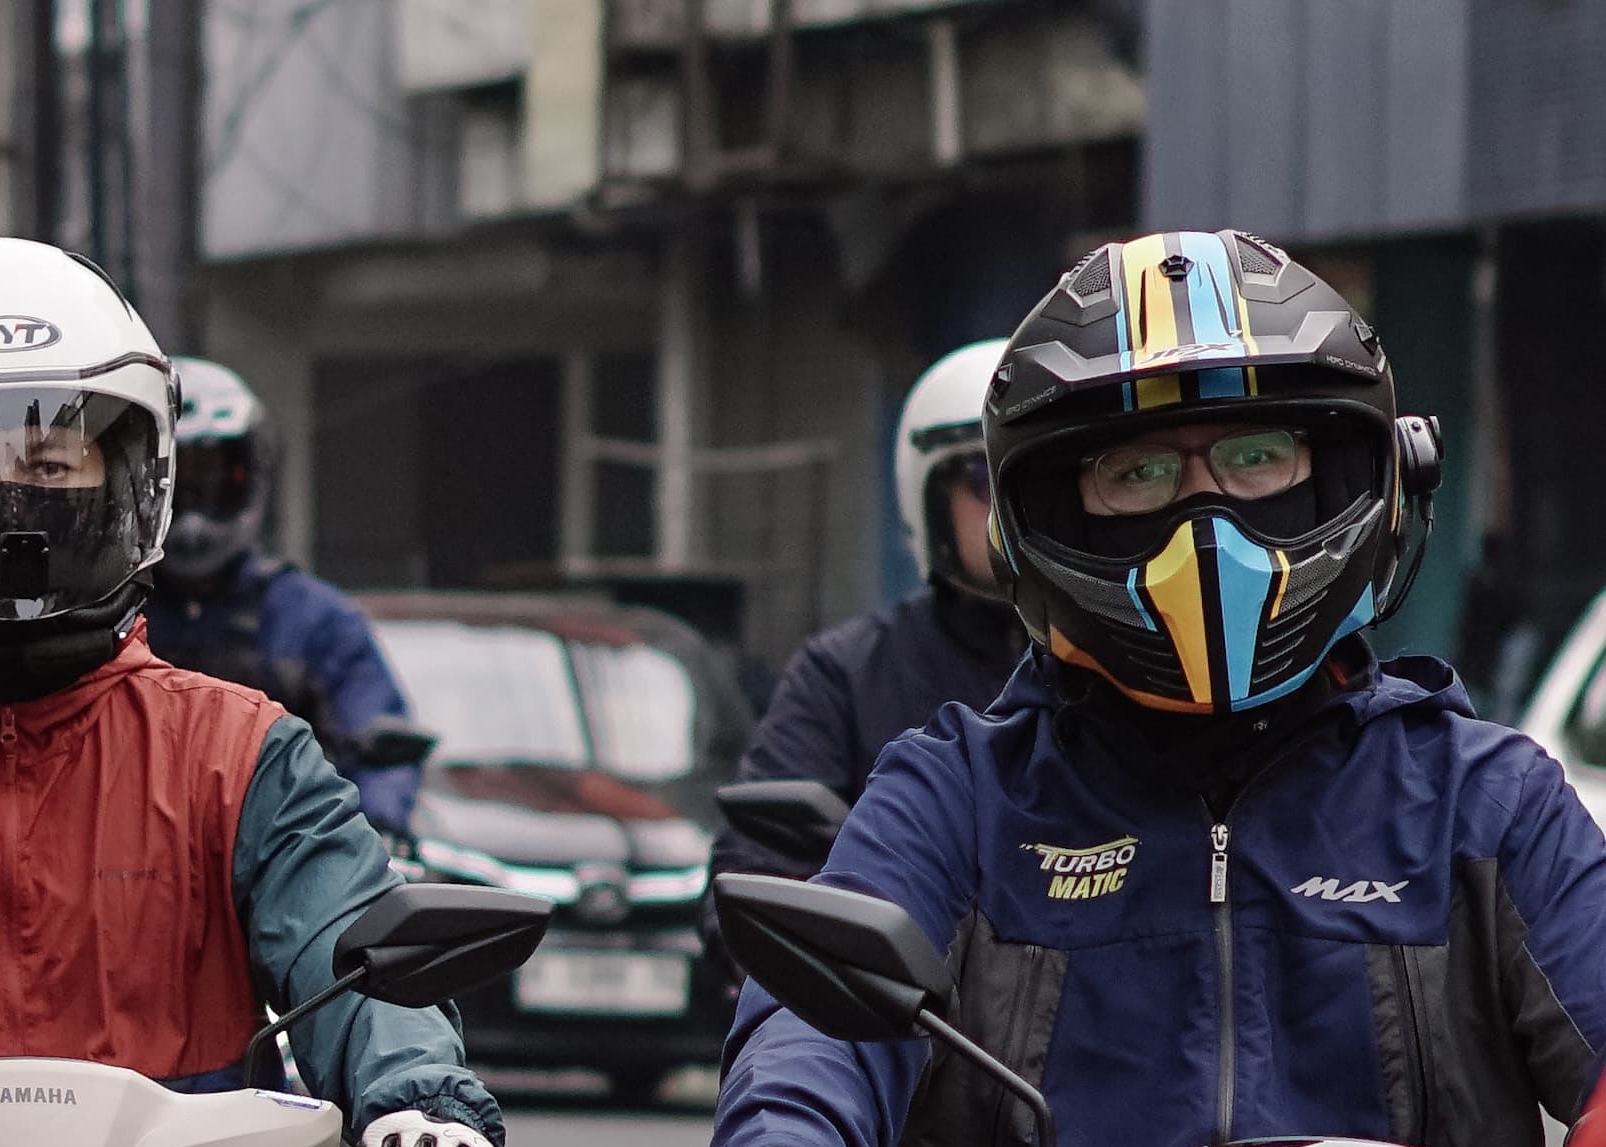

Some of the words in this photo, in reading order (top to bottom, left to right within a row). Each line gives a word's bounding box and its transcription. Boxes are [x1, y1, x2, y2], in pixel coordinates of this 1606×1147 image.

[1039, 844, 1136, 873] TURBO
[1047, 867, 1128, 899] MATIC
[1290, 876, 1410, 903] MAX
